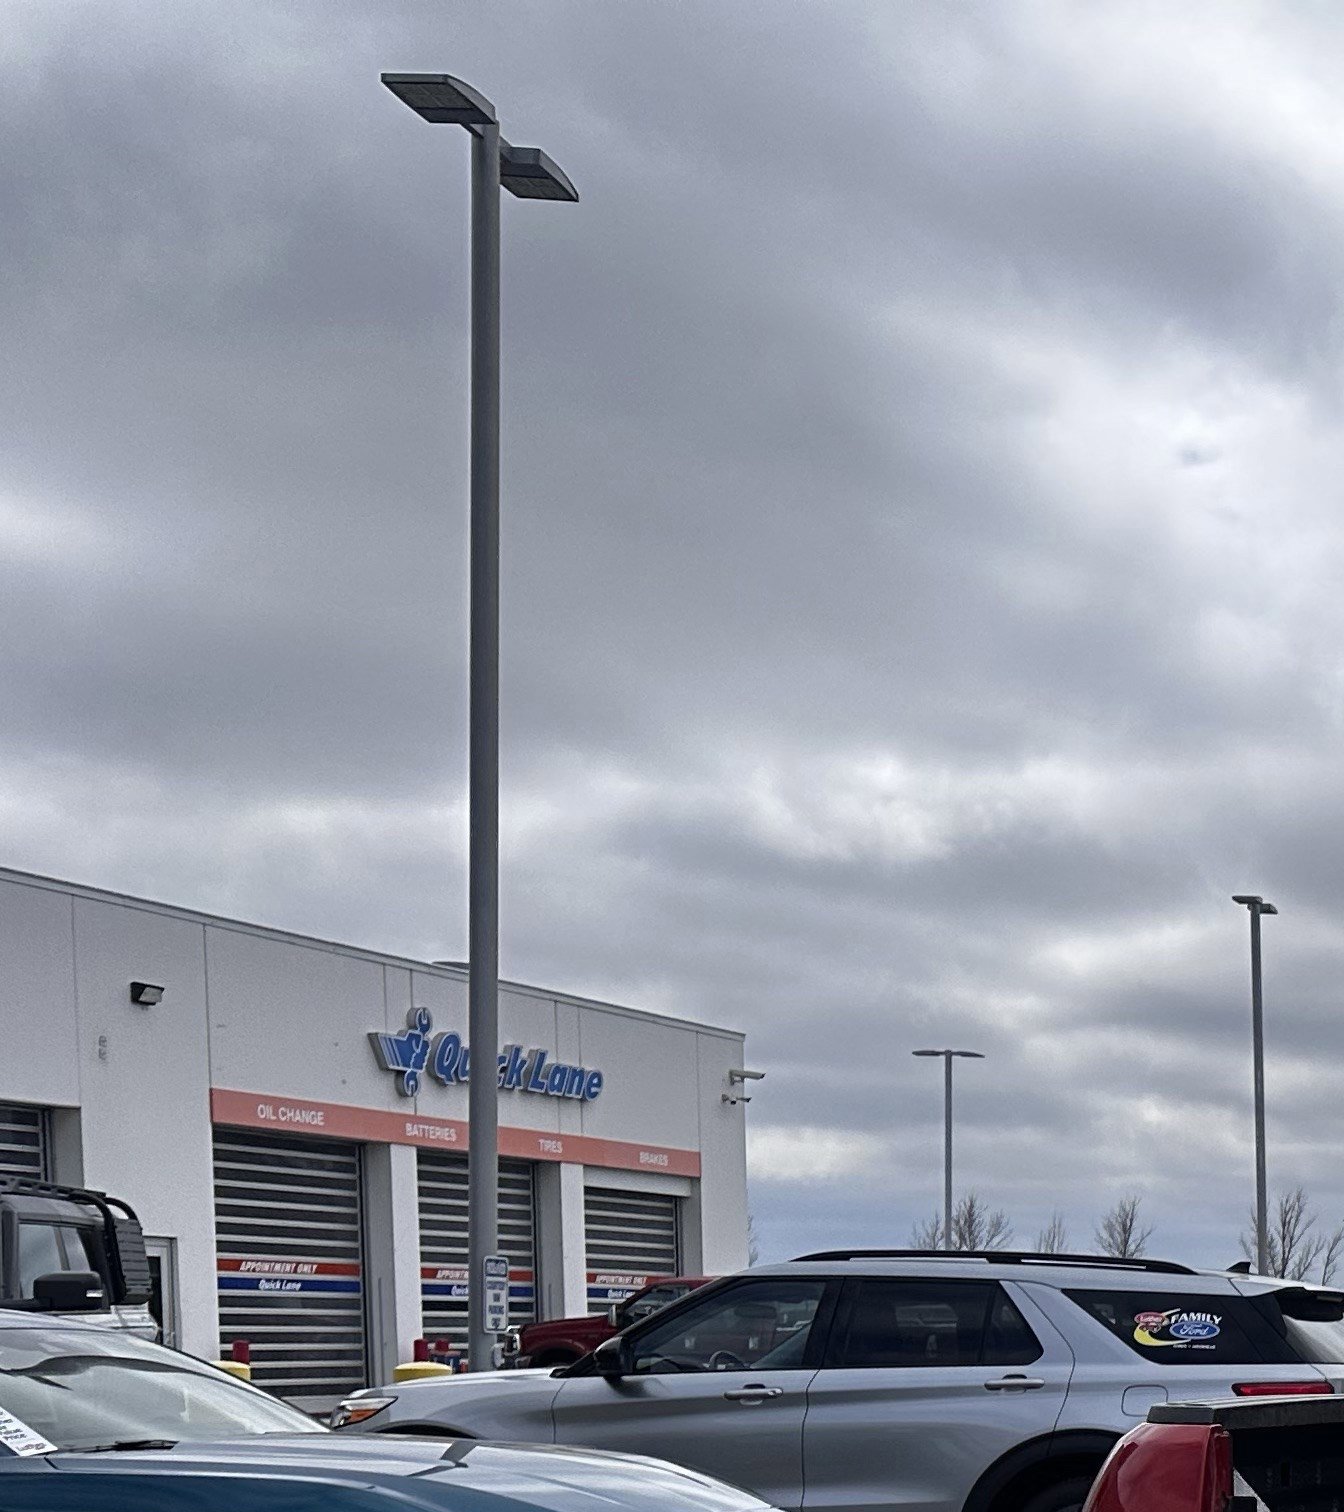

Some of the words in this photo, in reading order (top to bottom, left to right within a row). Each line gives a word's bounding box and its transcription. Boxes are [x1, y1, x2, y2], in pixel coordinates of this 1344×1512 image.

[528, 1049, 603, 1101] Lane
[257, 1103, 277, 1122] OIL
[278, 1106, 325, 1126] CHANGE
[405, 1122, 457, 1143] BATTERIES
[539, 1138, 563, 1154] TIRES
[639, 1151, 669, 1167] BRAKES
[239, 1260, 297, 1274] APPOINTMENT
[297, 1263, 319, 1274] ONLY
[258, 1279, 281, 1291] Quick
[281, 1280, 302, 1291] Lane
[1170, 1312, 1222, 1325] FAMILY
[1179, 1323, 1210, 1336] Ford
